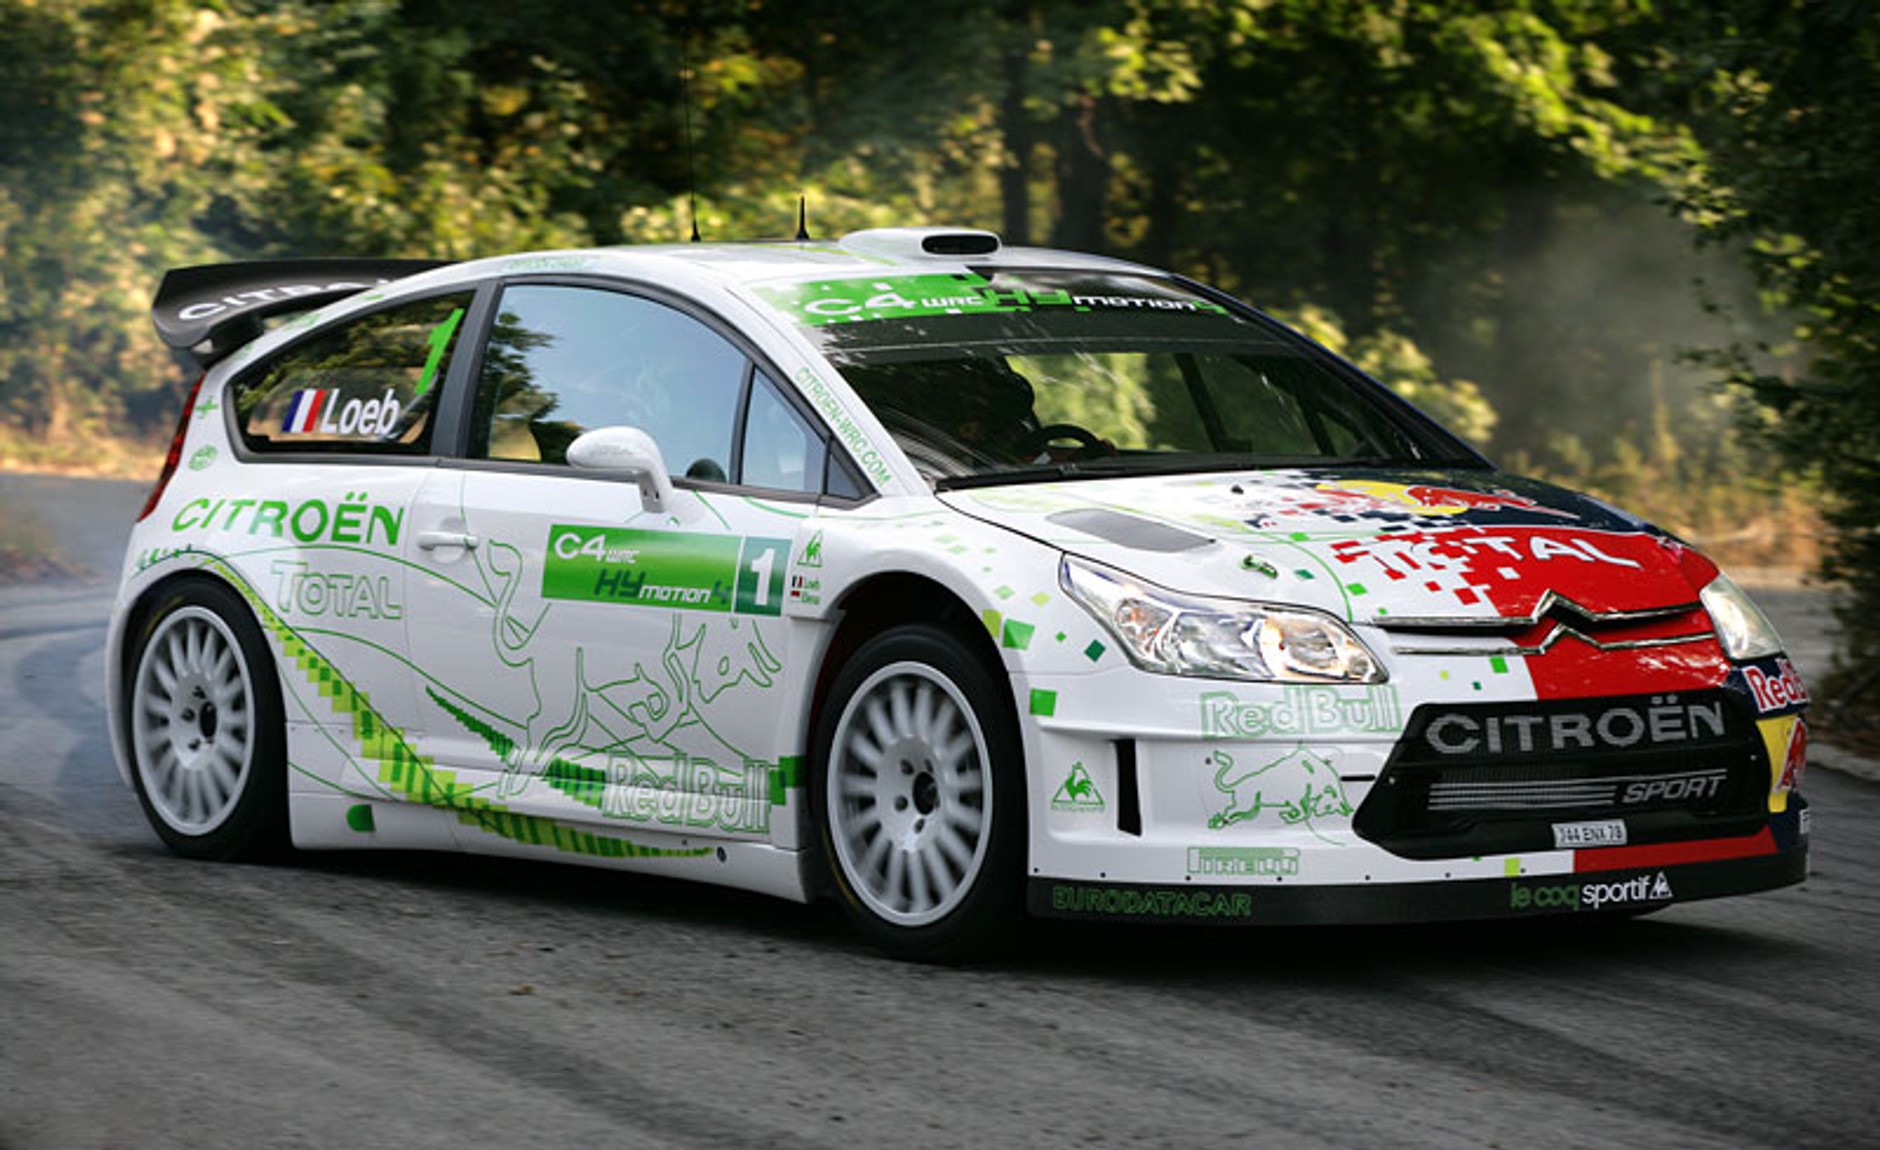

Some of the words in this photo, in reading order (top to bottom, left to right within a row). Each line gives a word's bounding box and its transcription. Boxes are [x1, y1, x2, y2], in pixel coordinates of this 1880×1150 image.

[804, 292, 917, 316] C4
[414, 308, 465, 396] 1
[320, 388, 400, 435] Loeb
[171, 492, 404, 546] CITROËN
[554, 532, 606, 562] C4
[1338, 535, 1643, 580] TOTAL
[751, 547, 777, 606] 1
[1425, 694, 1727, 756] CITROËN
[1622, 774, 1727, 804] SPORT
[1187, 847, 1300, 876] PIRELLI
[1052, 885, 1251, 916] EURODATACAR
[1510, 882, 1531, 908] le
[1534, 884, 1581, 912] coq
[1582, 875, 1650, 909] sportif
